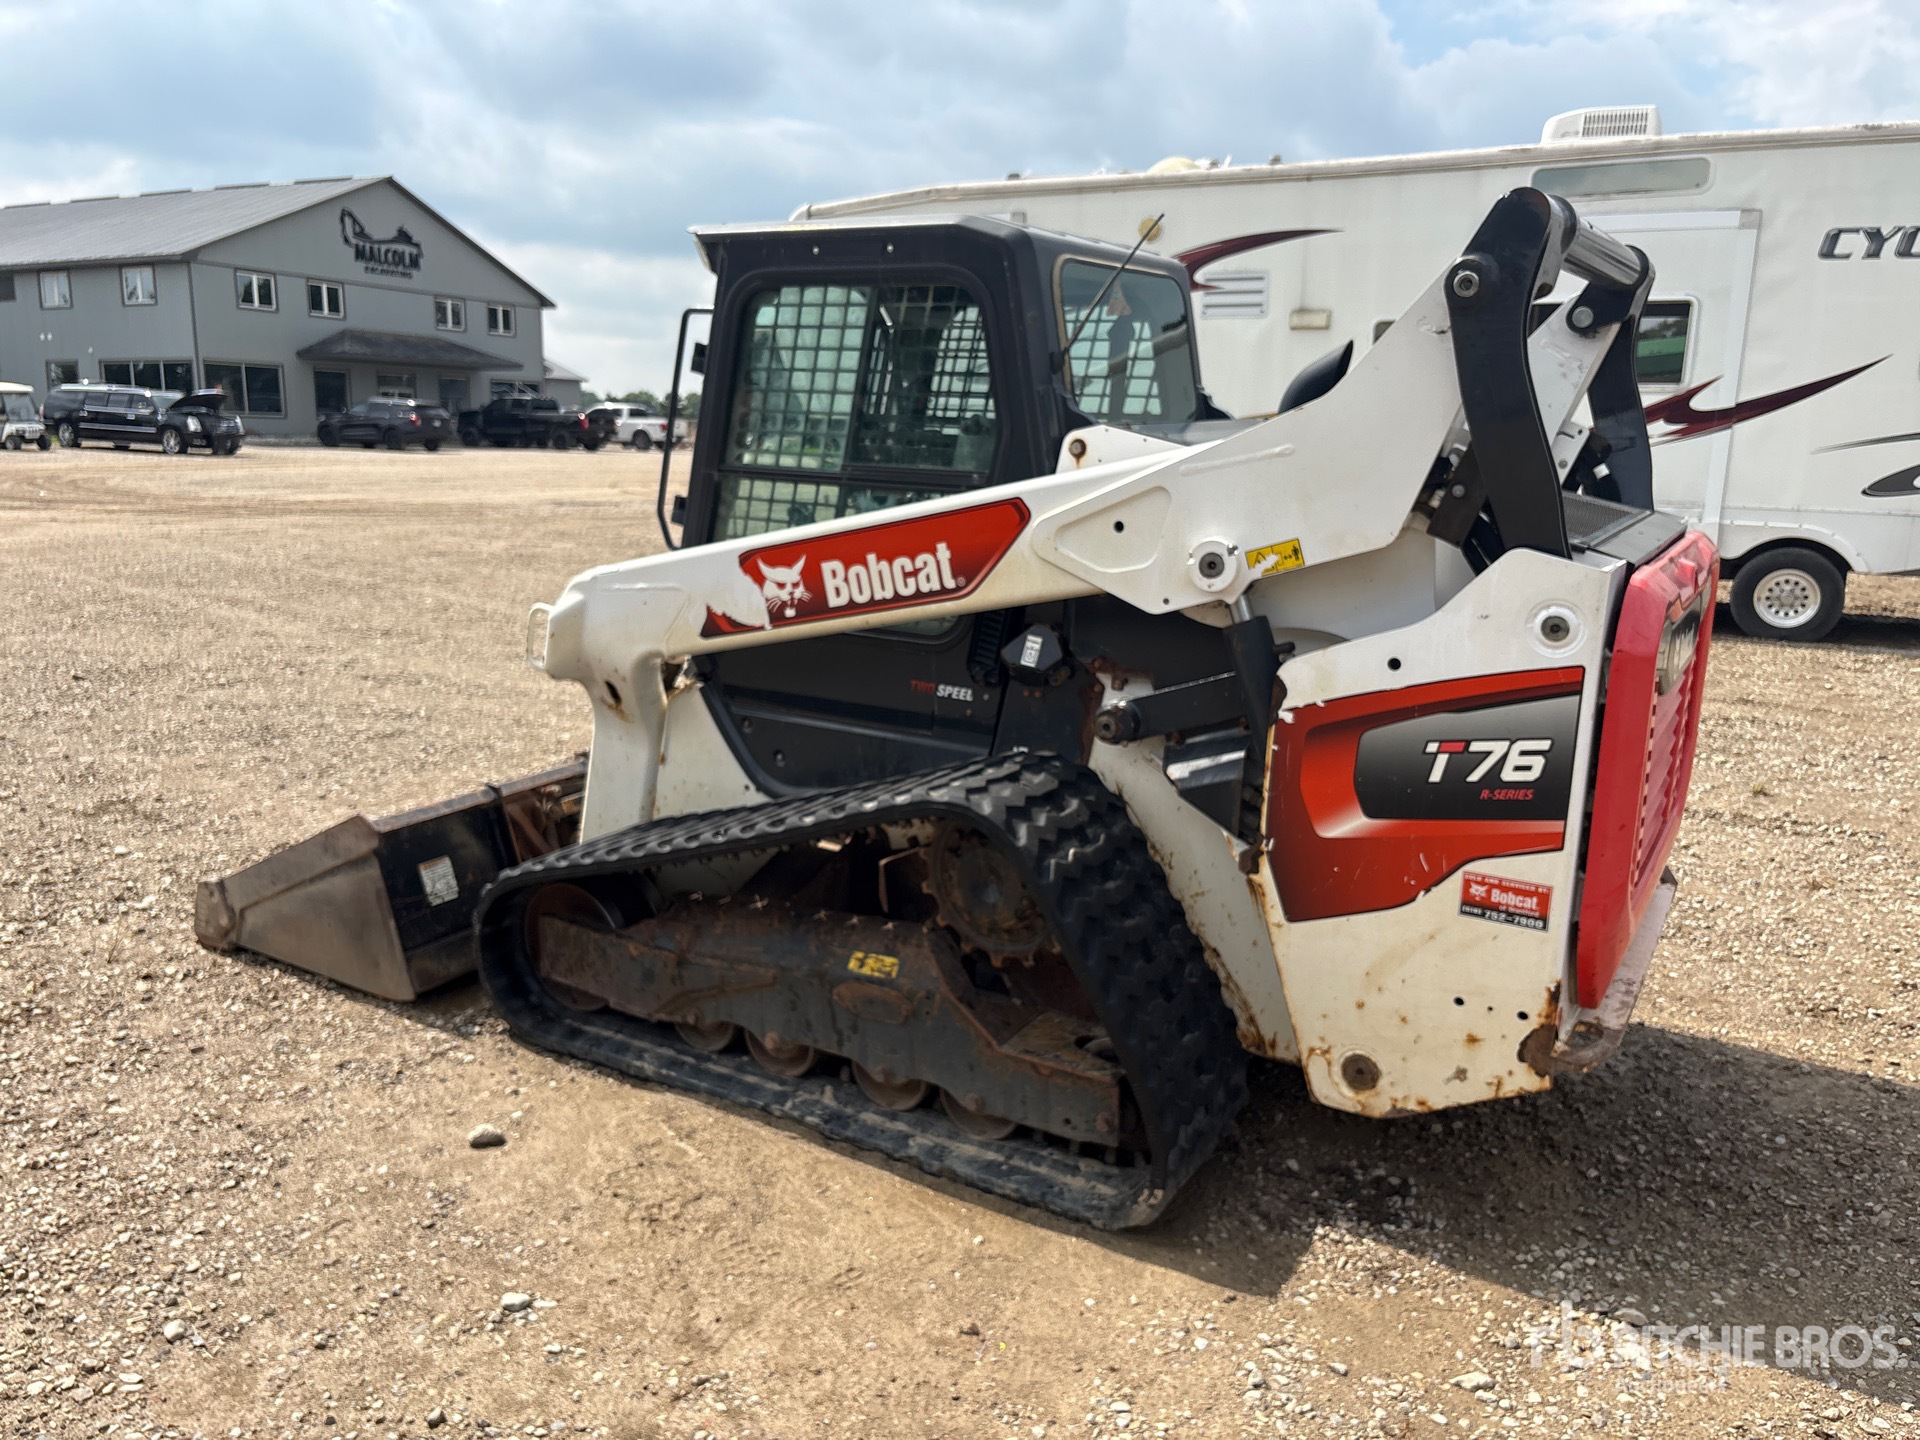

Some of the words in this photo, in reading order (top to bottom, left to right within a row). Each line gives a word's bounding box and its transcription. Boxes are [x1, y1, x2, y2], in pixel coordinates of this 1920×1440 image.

[355, 243, 420, 271] MALCOLM
[820, 541, 957, 609] Bobcat
[1424, 739, 1553, 783] T76
[1480, 788, 1535, 800] R-SERIES
[1490, 888, 1538, 910] Bobcat
